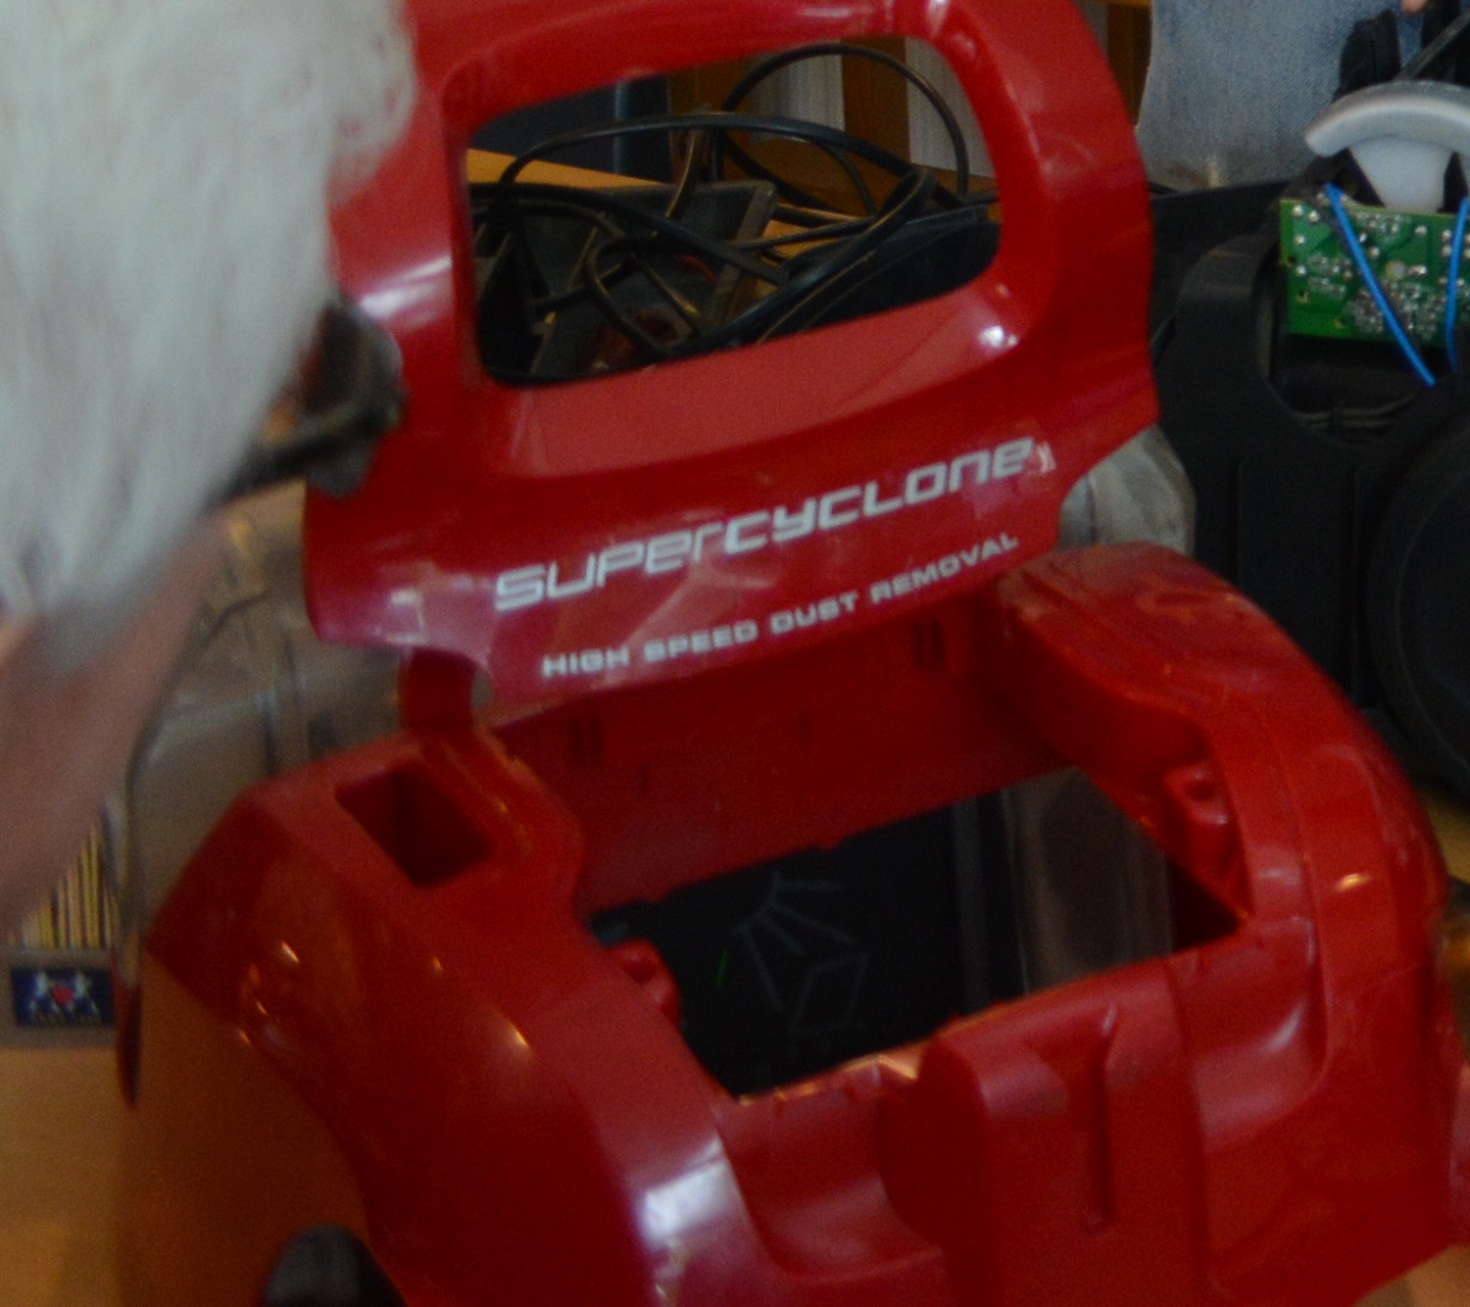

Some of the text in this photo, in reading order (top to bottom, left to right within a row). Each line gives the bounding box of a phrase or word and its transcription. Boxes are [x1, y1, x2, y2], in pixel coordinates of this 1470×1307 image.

[541, 531, 1021, 678] HIGH SPEED DUST REMOVAL
